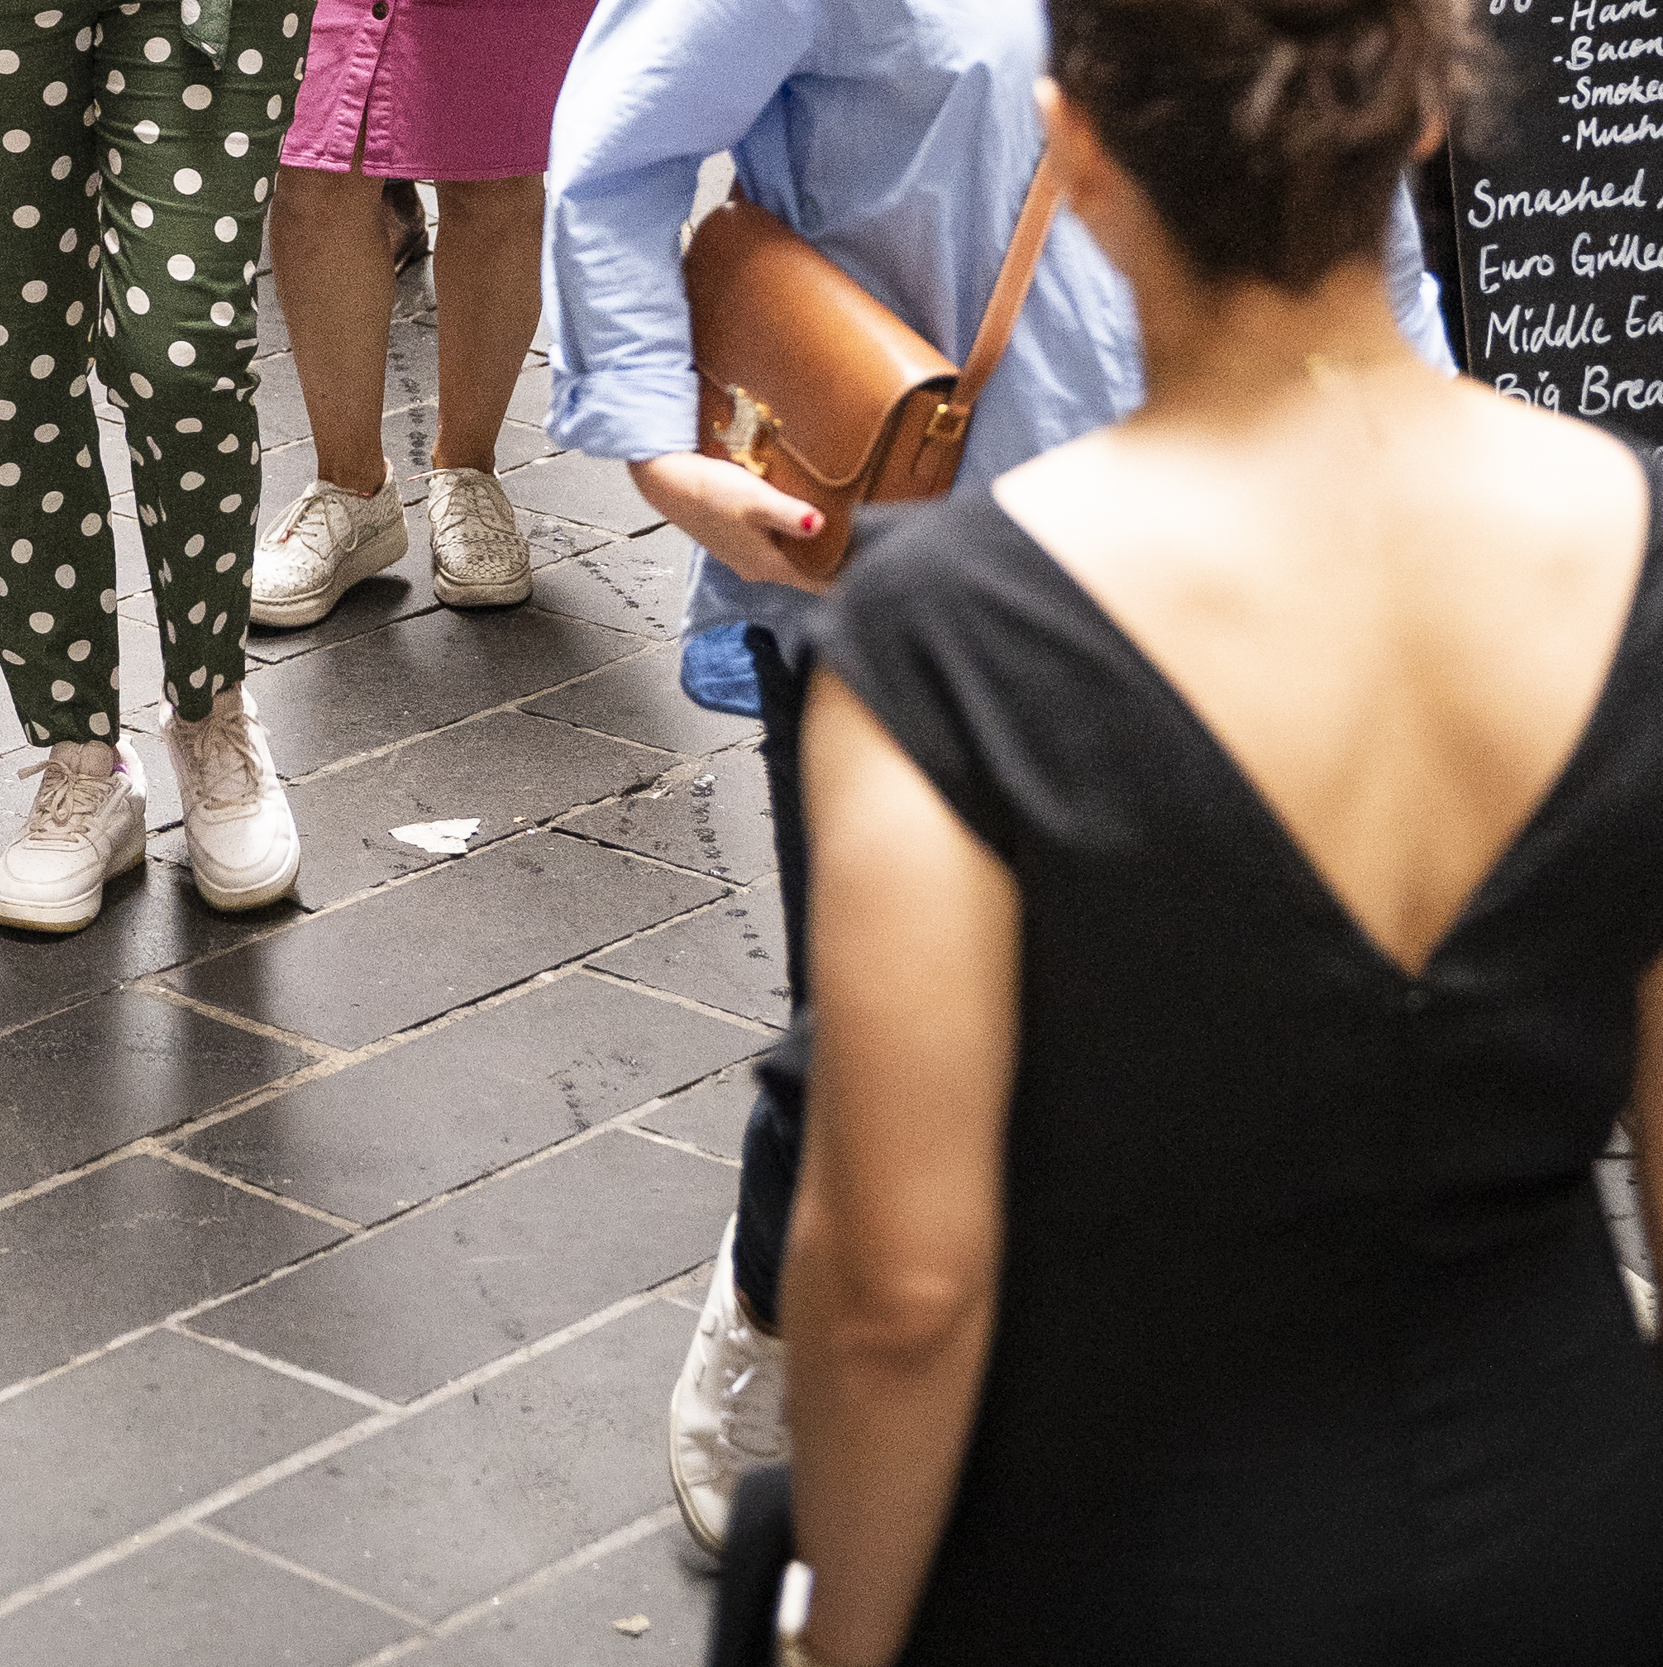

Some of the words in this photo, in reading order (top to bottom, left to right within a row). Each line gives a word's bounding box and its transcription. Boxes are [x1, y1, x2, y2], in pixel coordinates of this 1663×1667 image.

[1468, 168, 1646, 228] Smashed
[1480, 243, 1555, 294] Euro
[1485, 303, 1612, 358] Middle
